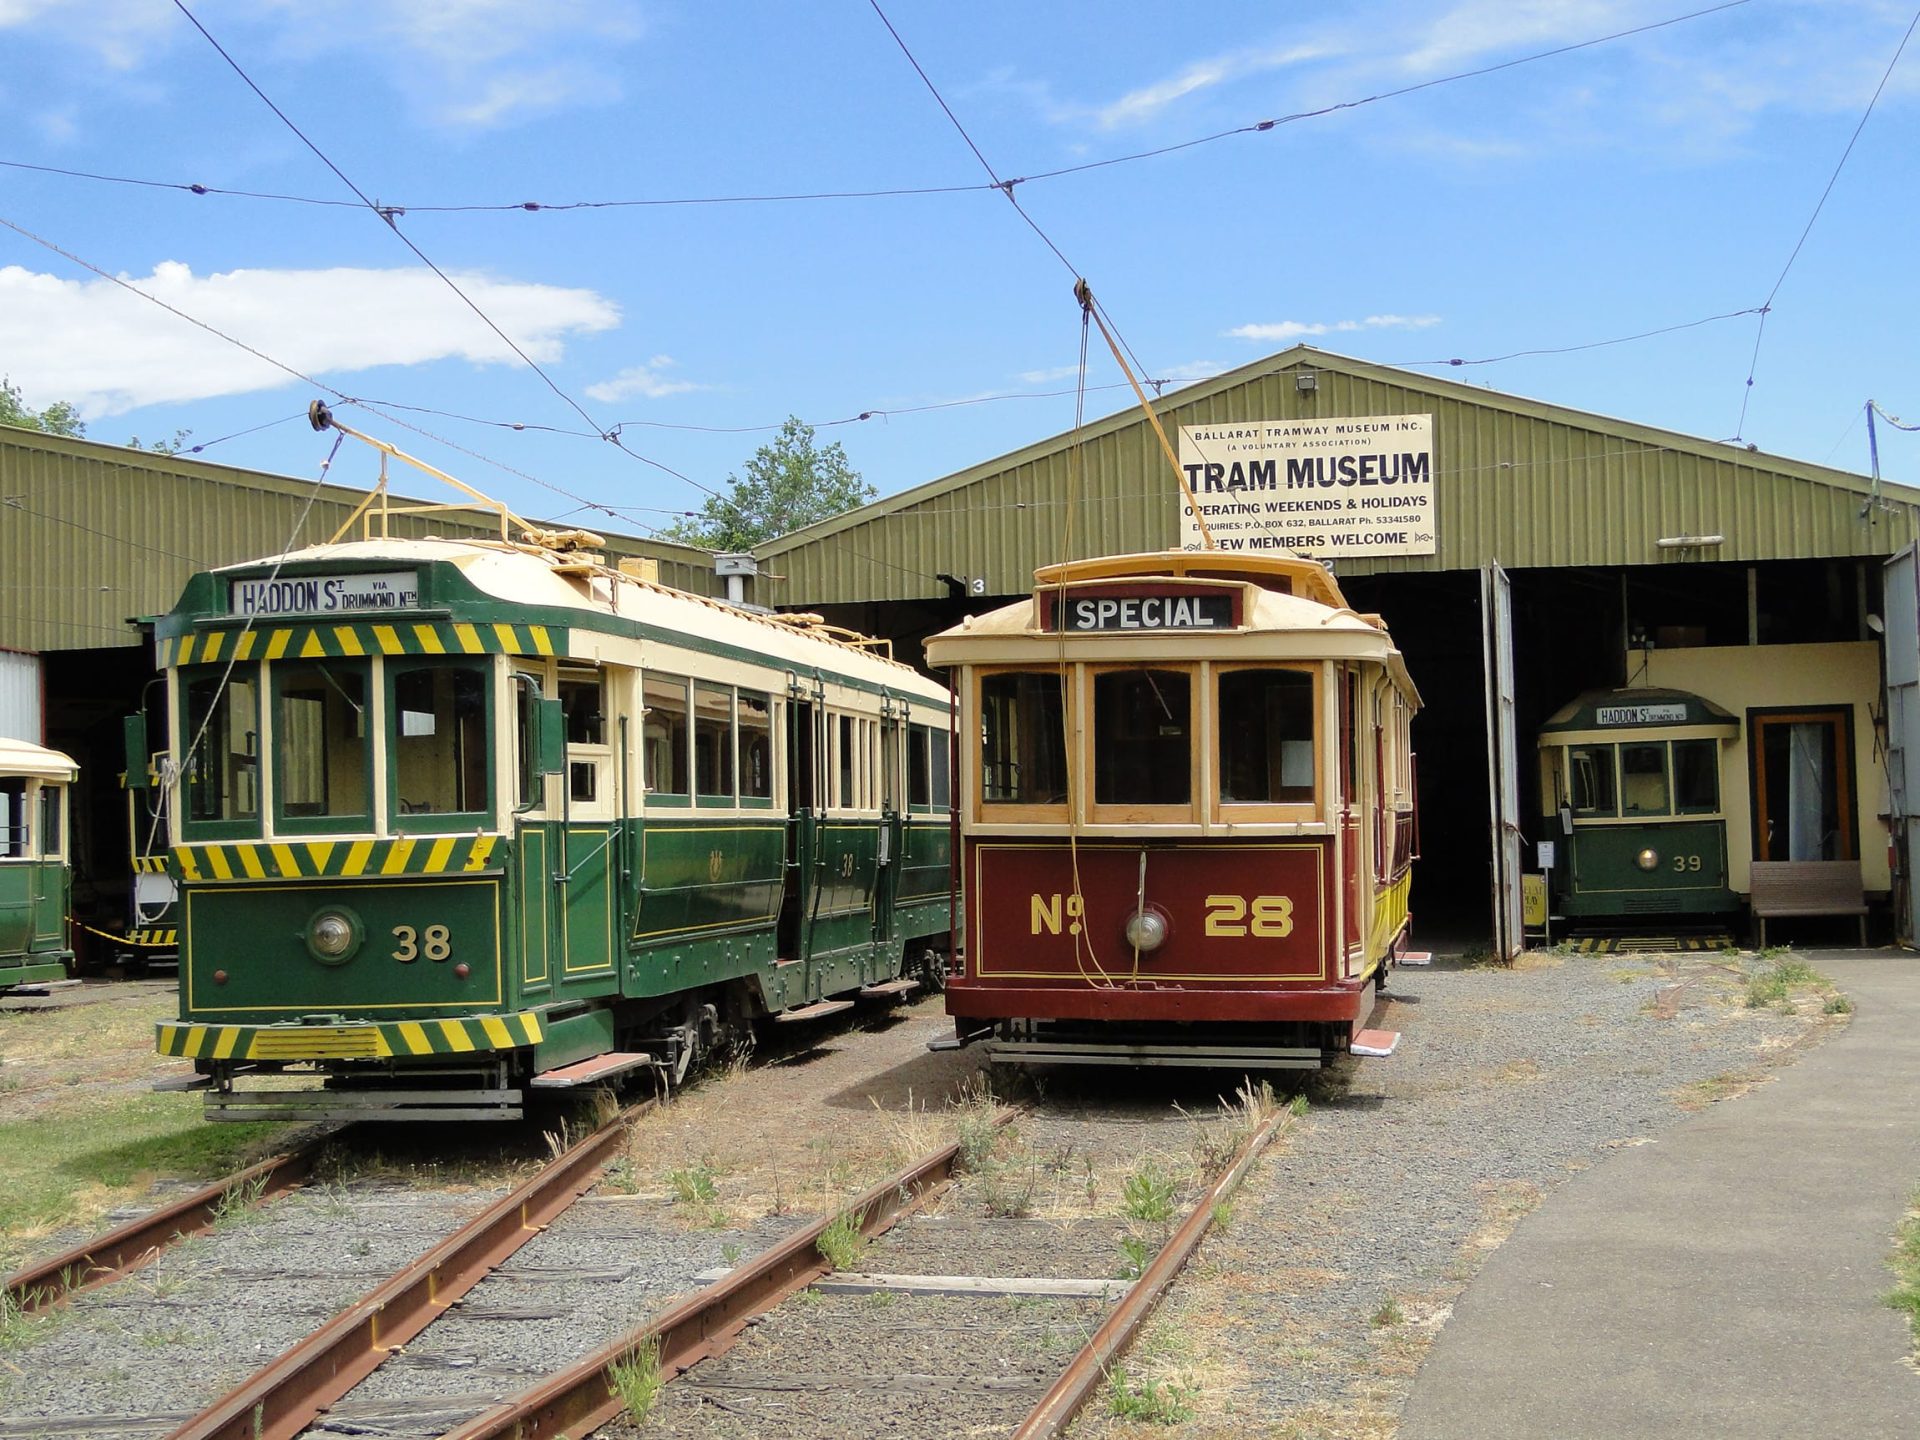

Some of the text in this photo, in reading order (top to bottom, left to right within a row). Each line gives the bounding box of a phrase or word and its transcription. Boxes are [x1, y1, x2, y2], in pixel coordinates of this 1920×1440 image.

[1195, 422, 1422, 441] BALLARAT TRAMWAY MUSEUM INC.
[1227, 438, 1371, 453] (A VOLUNTARY ASSOCIATION)
[1183, 452, 1430, 495] TRAM MUSEUM
[1265, 500, 1342, 513] WEEKENDS
[1346, 498, 1357, 510] &
[1361, 495, 1428, 509] HOLIDAYS
[1245, 520, 1263, 531] P.O.
[1265, 519, 1284, 529] BOX
[1286, 519, 1306, 529] 632,
[1308, 517, 1356, 527] BALLARAT
[1359, 516, 1373, 525] Ph.
[1376, 515, 1421, 524] 53341580
[1209, 532, 1408, 551] EW MEMBERS WELCOME
[372, 582, 387, 591] VIA
[972, 579, 985, 594] 3
[242, 580, 319, 615] HADDON
[342, 592, 395, 610] DRUMMOND
[1076, 597, 1214, 630] SPECIAL
[1601, 708, 1638, 724] HADDON
[842, 853, 854, 878] 38
[1673, 855, 1702, 872] 39
[1205, 894, 1294, 937] 28
[391, 924, 451, 962] 38
